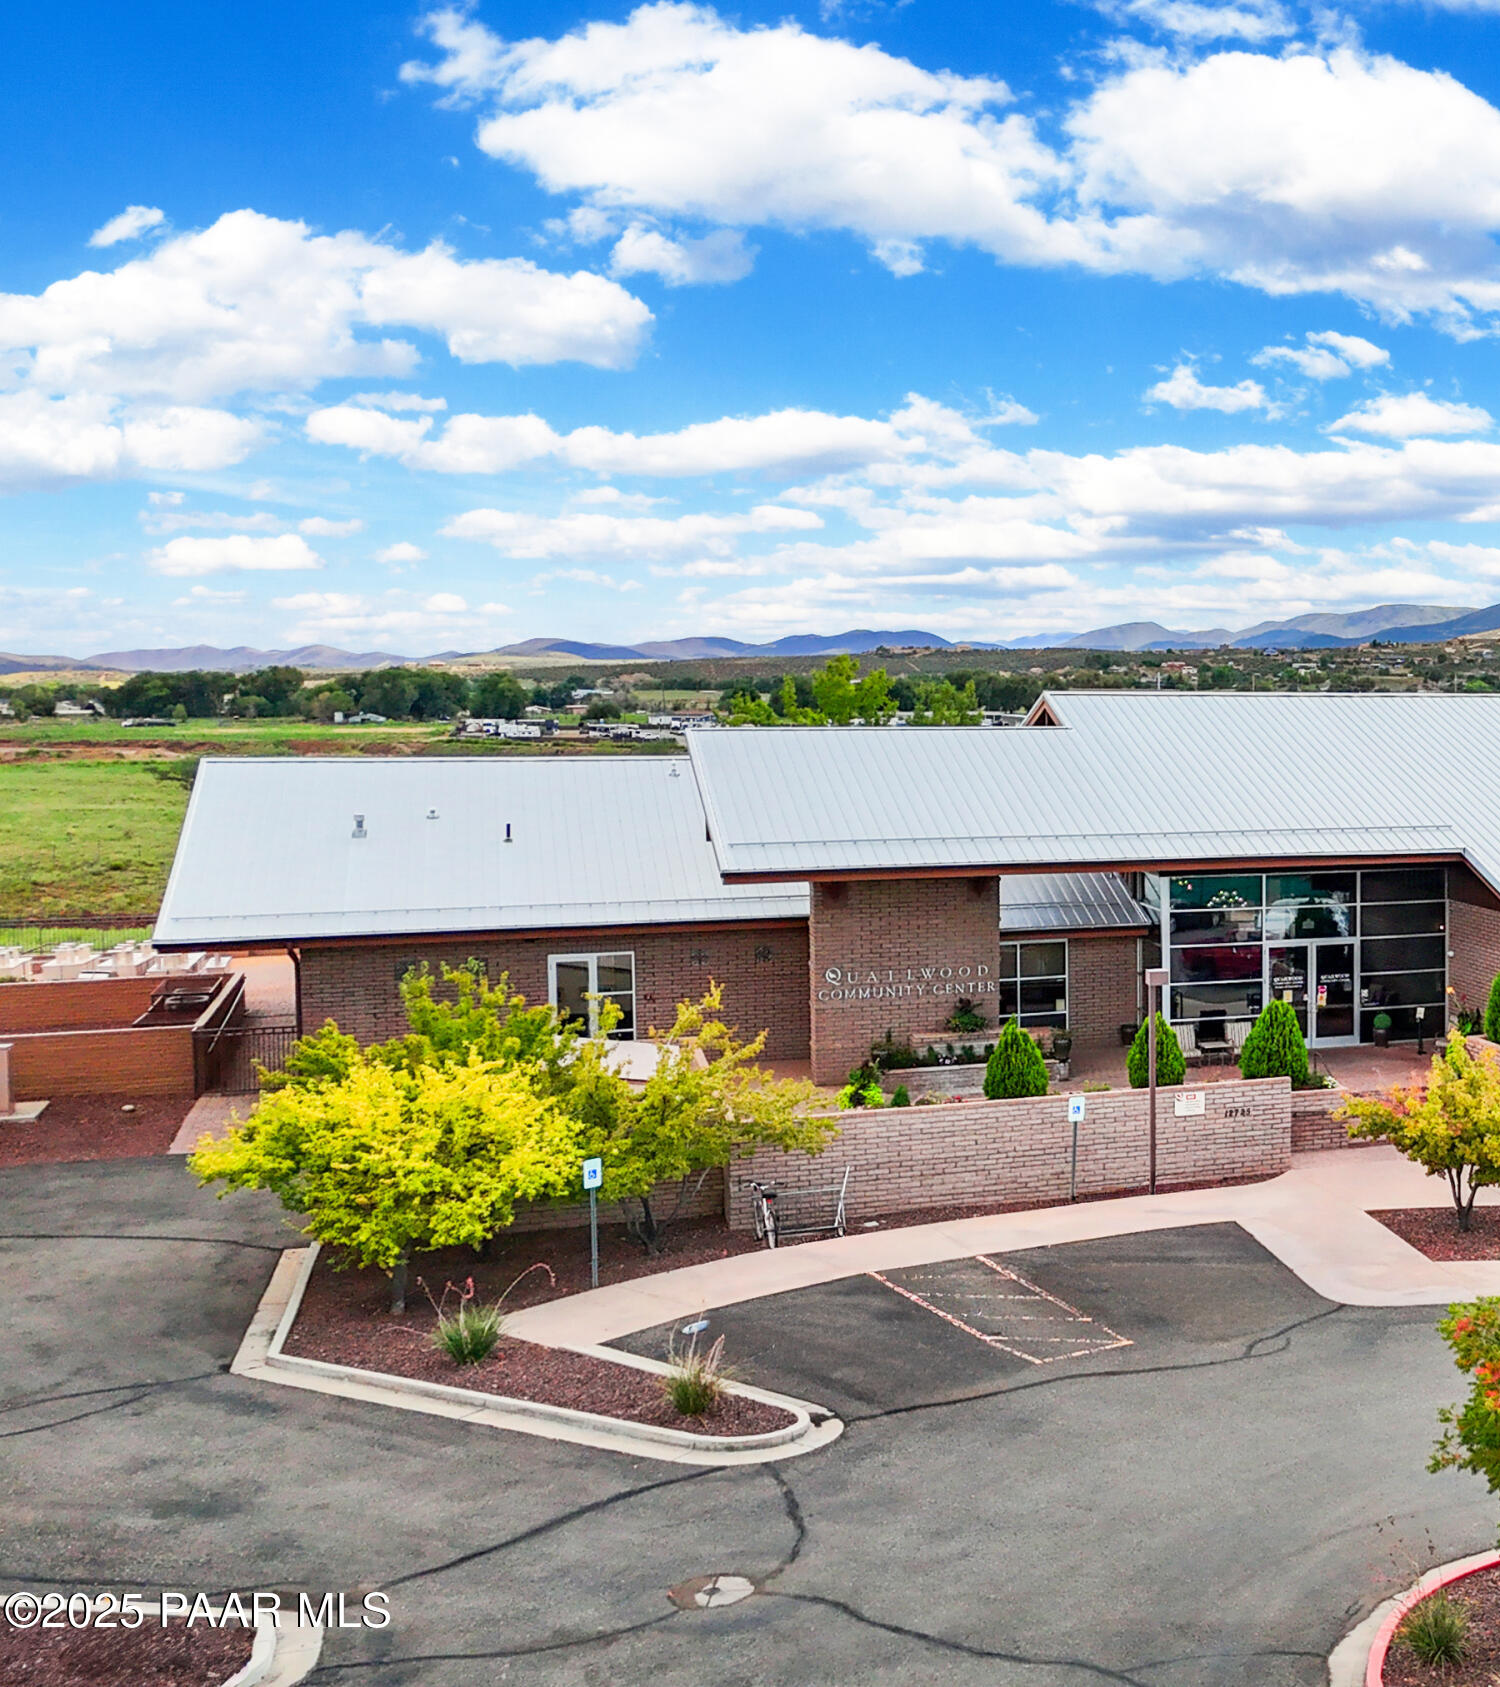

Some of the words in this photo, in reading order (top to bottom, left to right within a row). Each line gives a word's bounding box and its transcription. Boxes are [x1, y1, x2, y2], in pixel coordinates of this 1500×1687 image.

[825, 965, 988, 985] QUAILWOOD
[818, 984, 925, 1001] COMMUNITY
[933, 981, 996, 995] CENTER
